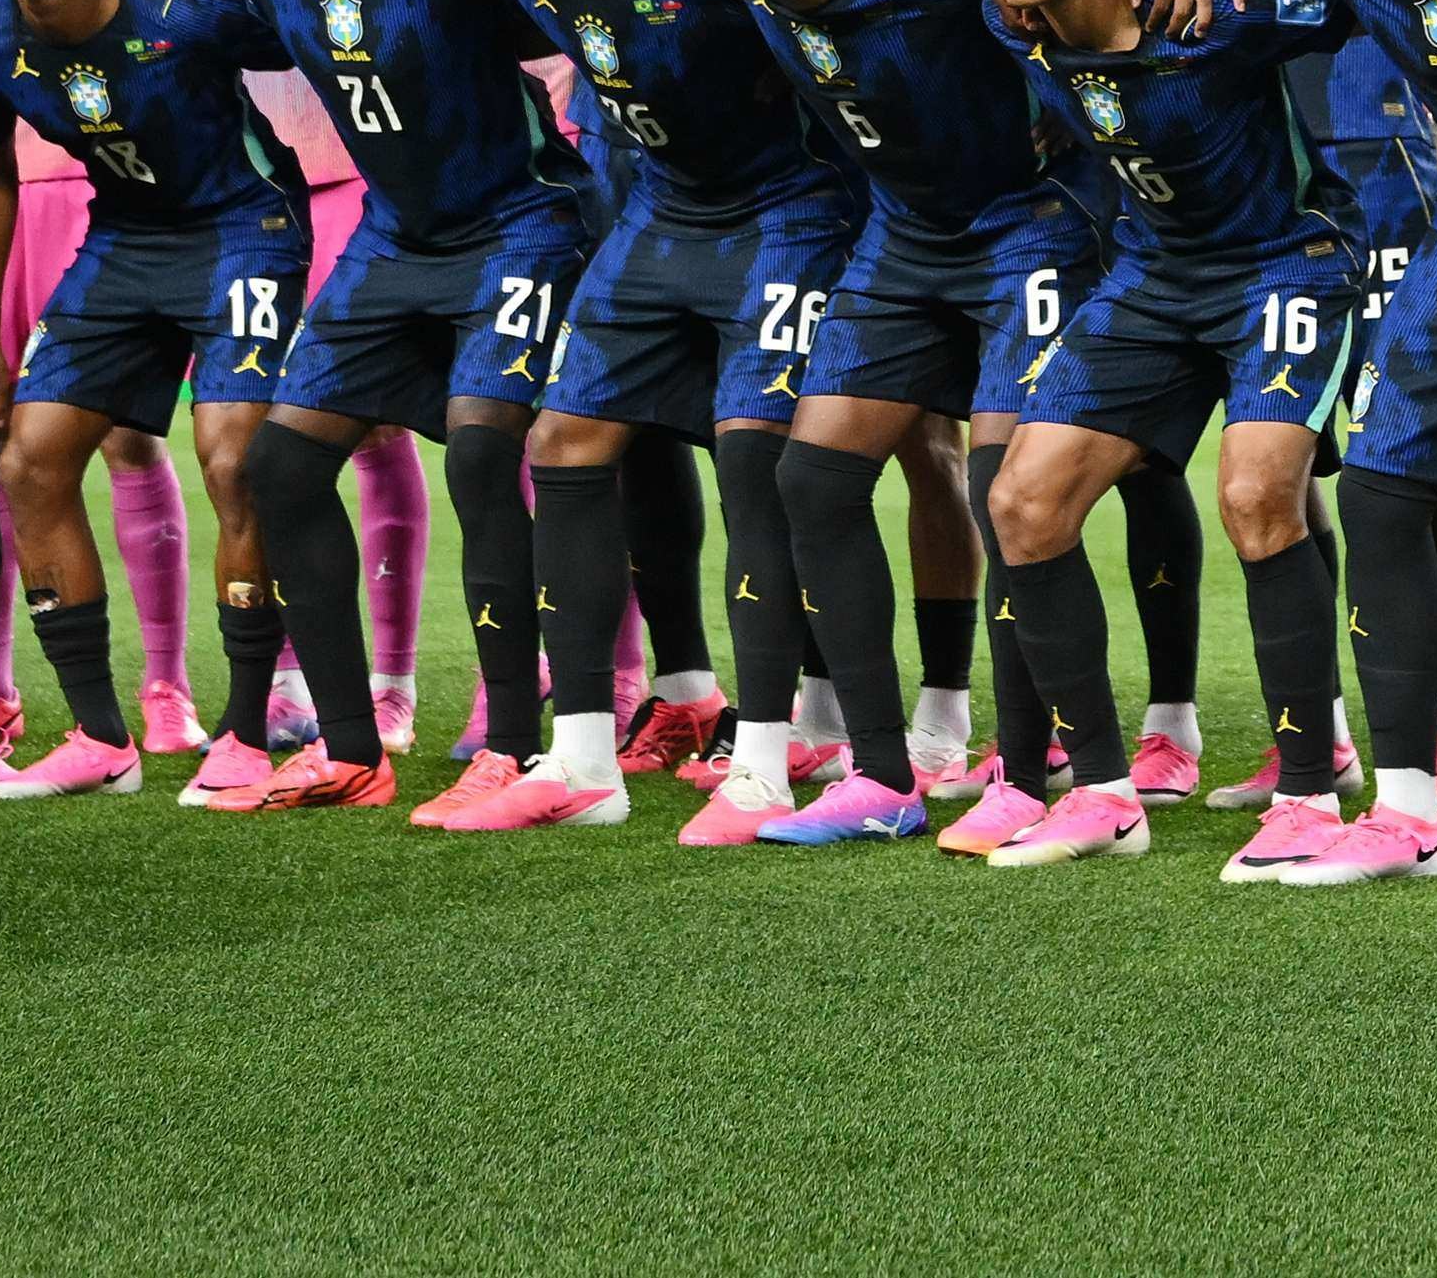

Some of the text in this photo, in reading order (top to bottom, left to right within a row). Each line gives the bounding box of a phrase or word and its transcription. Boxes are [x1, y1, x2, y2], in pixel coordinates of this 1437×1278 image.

[331, 50, 371, 61] BRASIL
[80, 122, 123, 134] BRASIL
[336, 75, 403, 133] 21
[837, 101, 881, 148] 6
[94, 141, 157, 184] 18
[1110, 155, 1176, 202] 16
[227, 277, 279, 340] 18
[494, 276, 553, 343] 21
[1026, 269, 1060, 337] 6
[1262, 293, 1318, 356] 16
